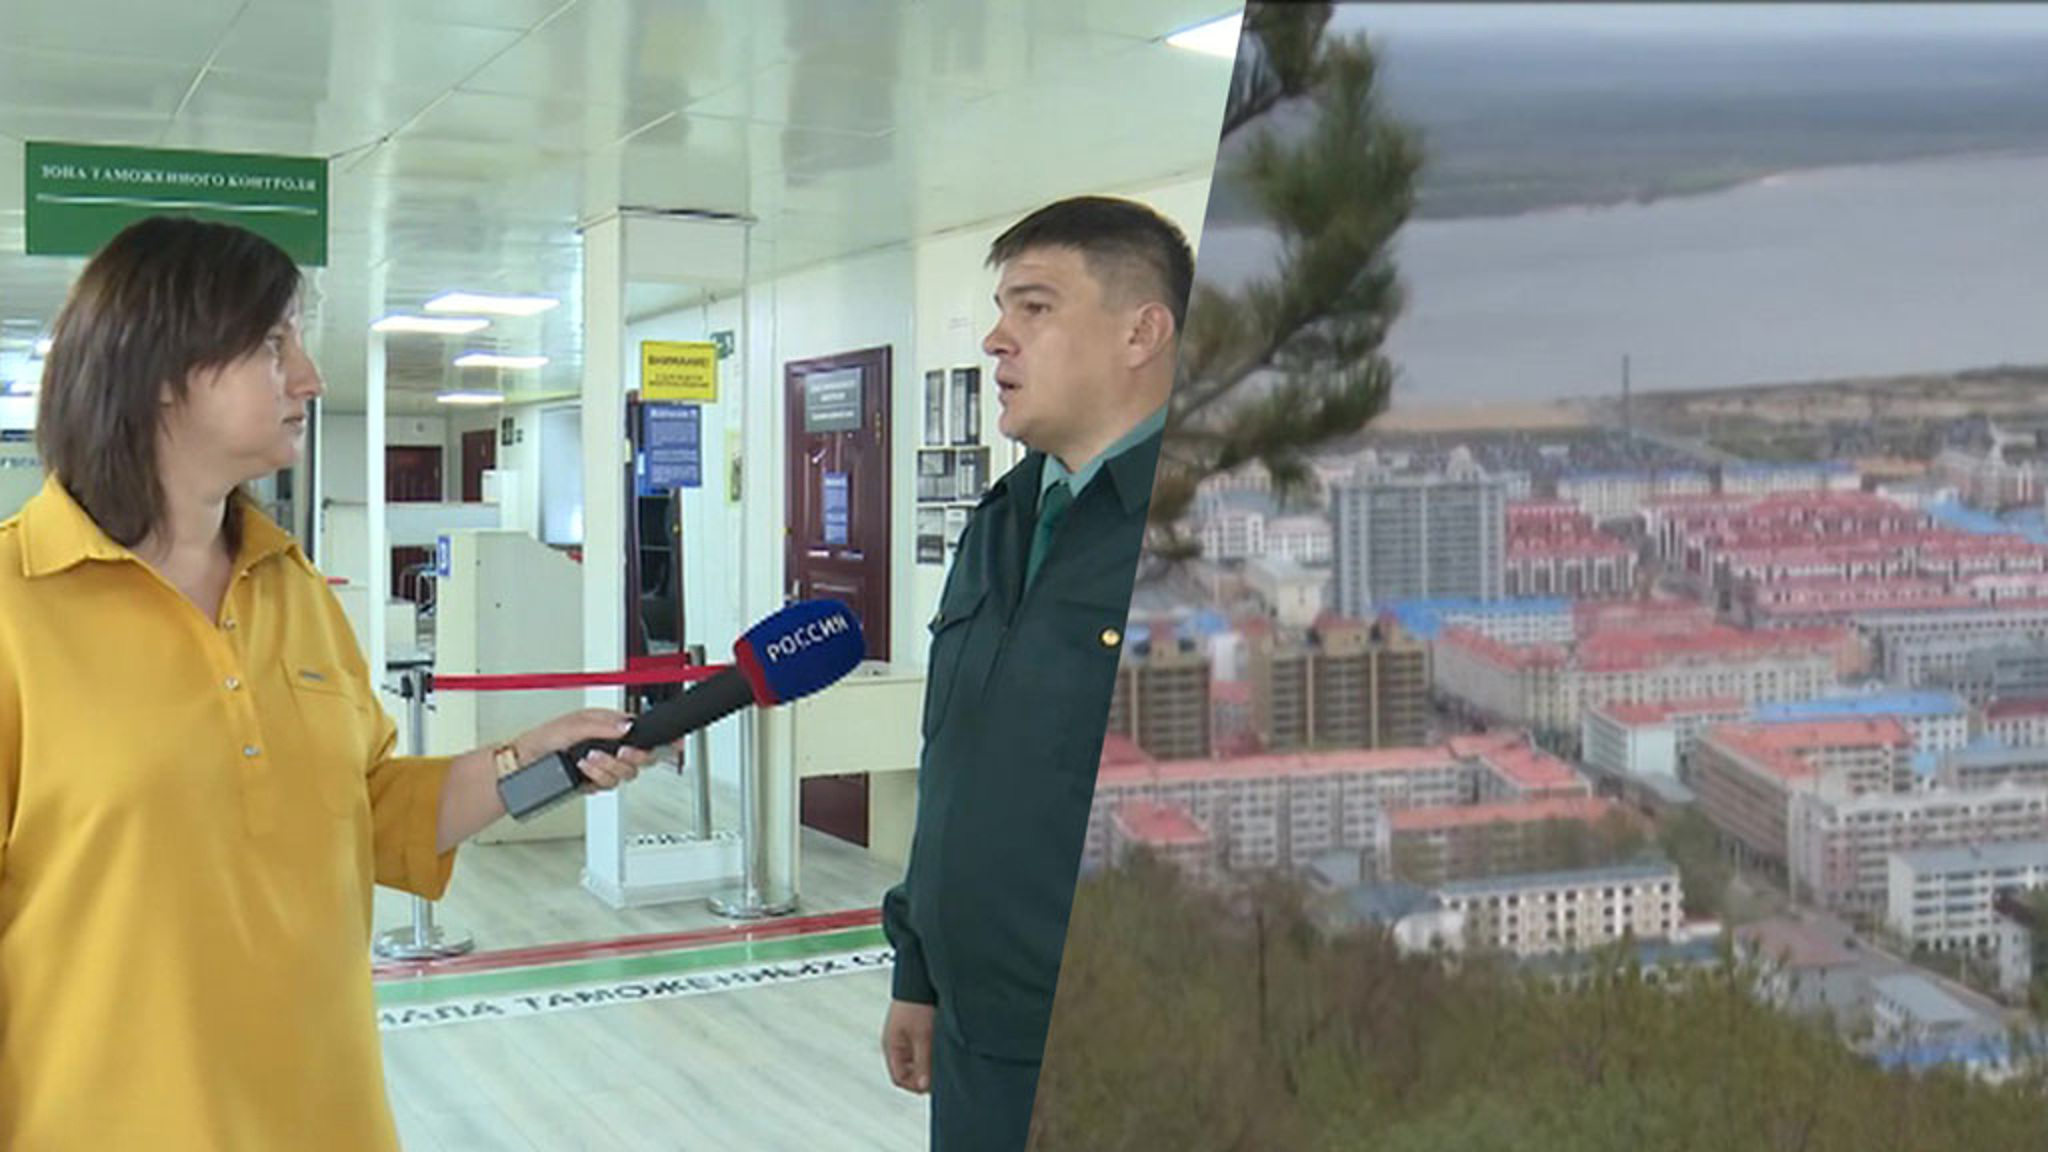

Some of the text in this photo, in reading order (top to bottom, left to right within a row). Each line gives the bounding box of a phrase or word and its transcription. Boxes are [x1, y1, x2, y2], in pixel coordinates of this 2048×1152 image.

[41, 164, 317, 192] ЗОНА ТАМОЖЕННОГО КОНТРОЛЯ
[765, 613, 849, 663] РОССИЯ
[513, 960, 848, 1011] ТАМОЖЕННЫХ
